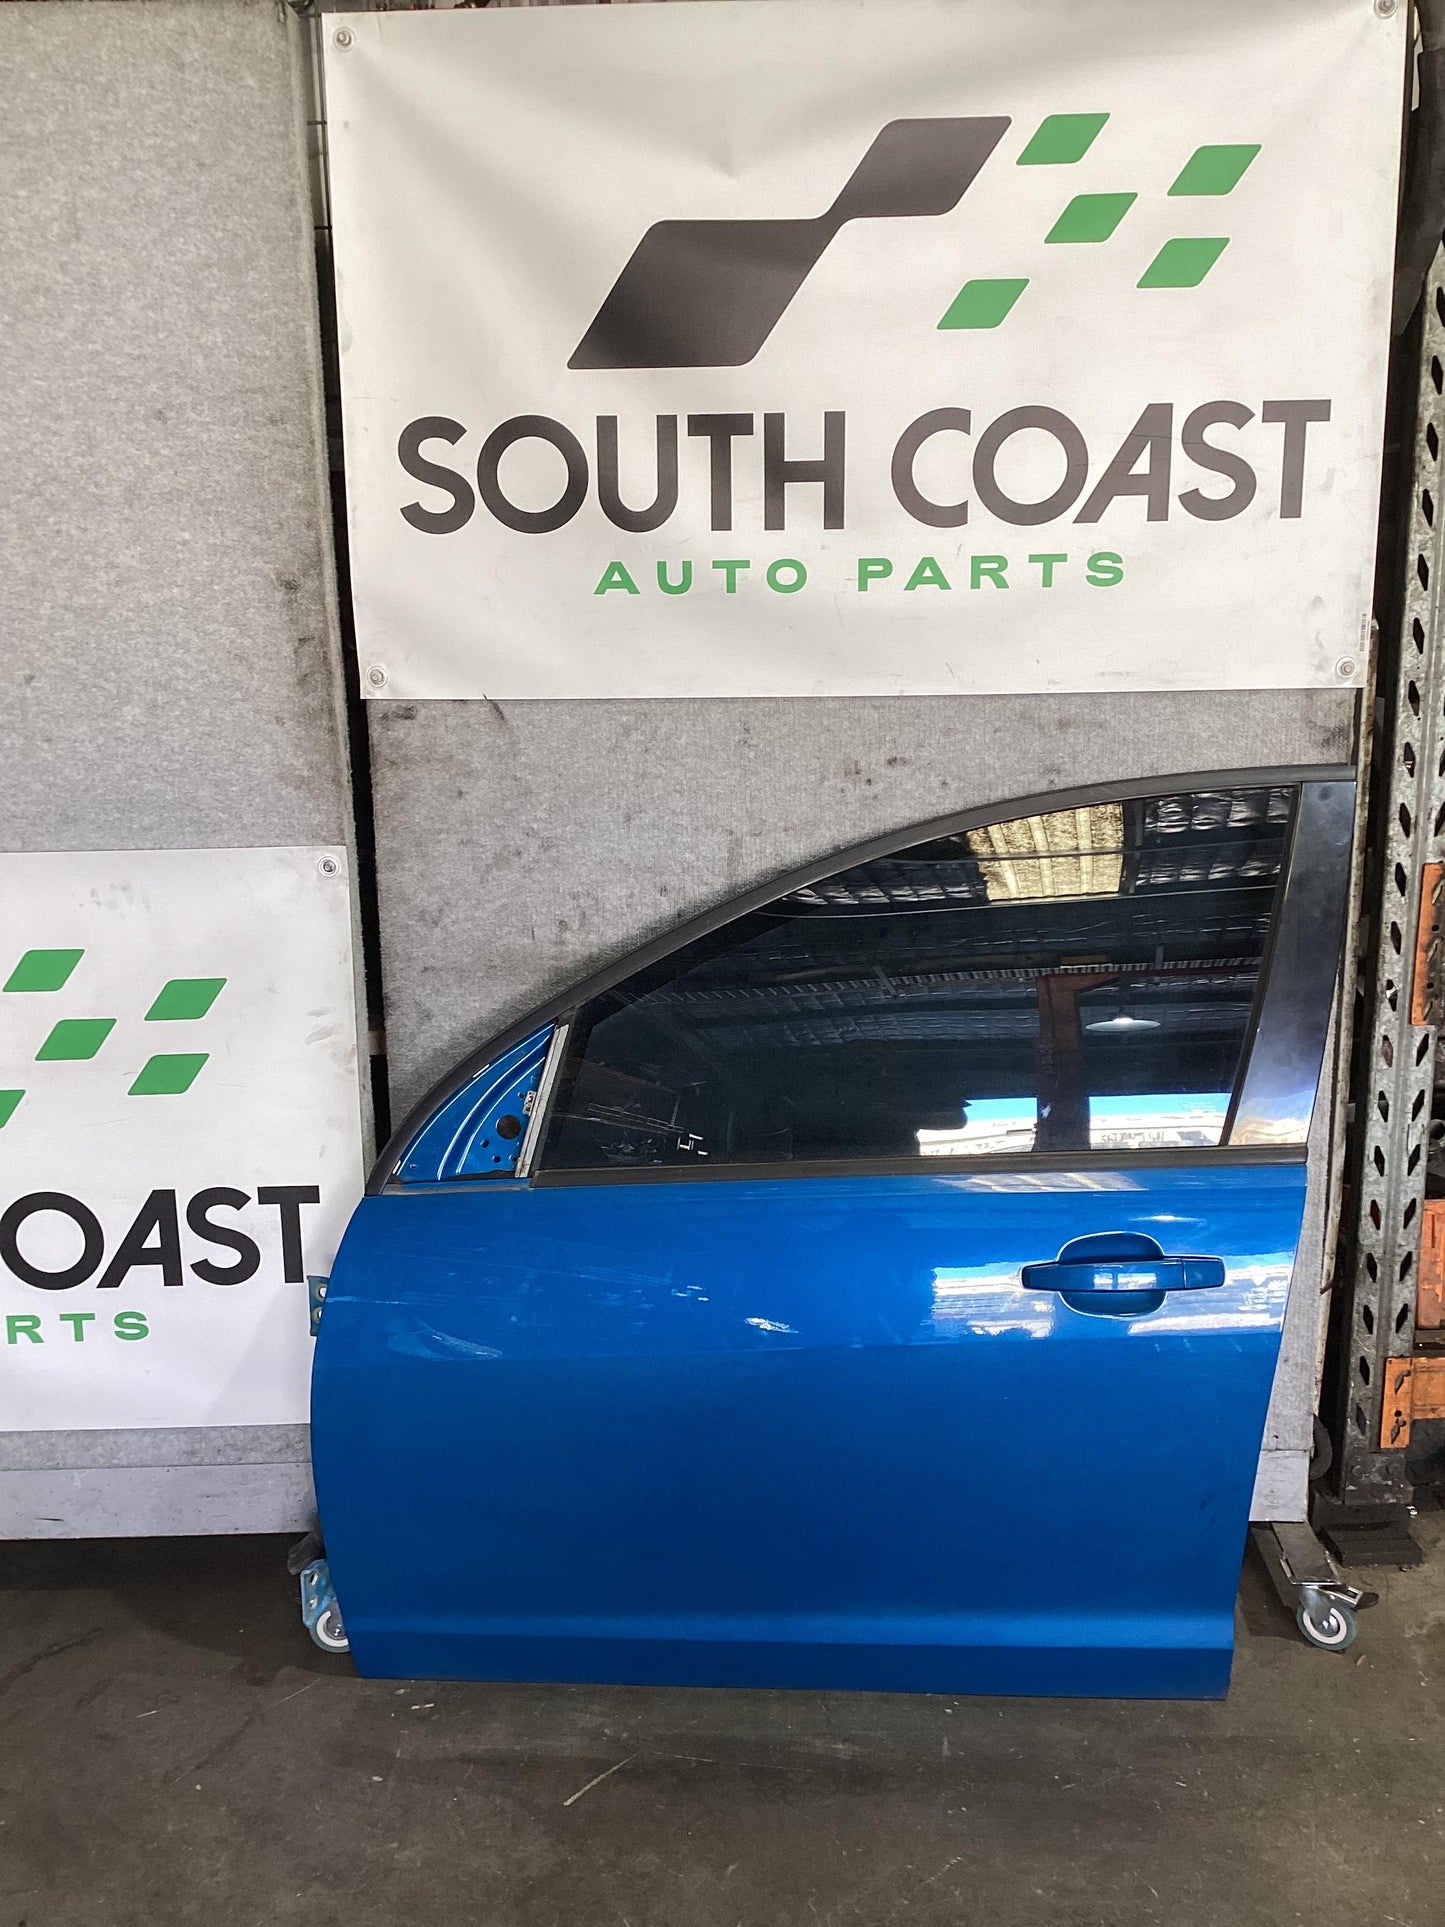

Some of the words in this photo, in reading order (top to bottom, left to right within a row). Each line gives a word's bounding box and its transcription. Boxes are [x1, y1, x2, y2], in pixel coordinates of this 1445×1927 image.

[398, 411, 845, 534] SOUTH
[892, 400, 1332, 528] COAST
[596, 560, 806, 595] AUTO
[859, 553, 1123, 592] PARTS
